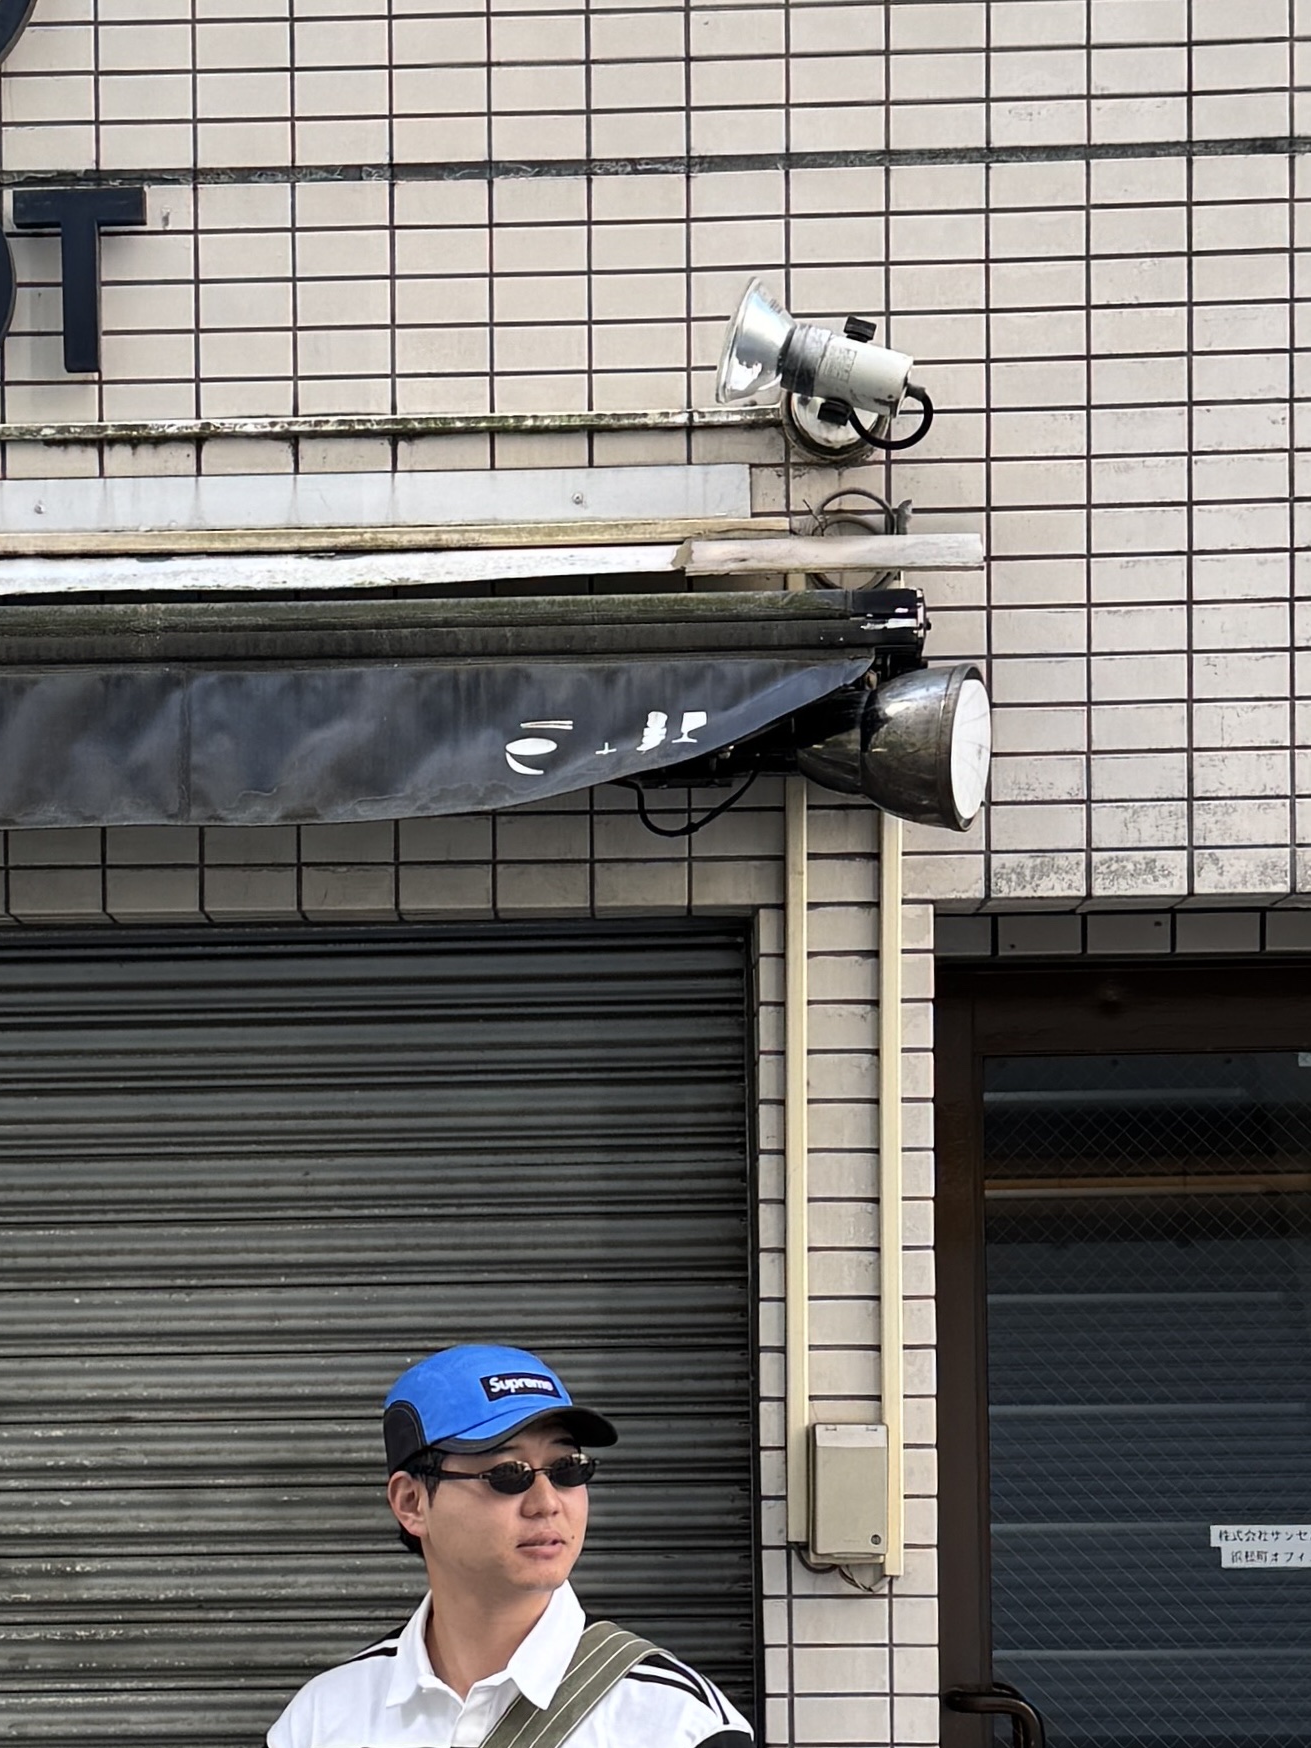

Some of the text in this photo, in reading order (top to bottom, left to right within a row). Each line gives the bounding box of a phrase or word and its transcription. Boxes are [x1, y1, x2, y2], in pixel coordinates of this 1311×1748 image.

[489, 1376, 554, 1393] Supreme
[1219, 1529, 1311, 1542] 株式会社サンセ
